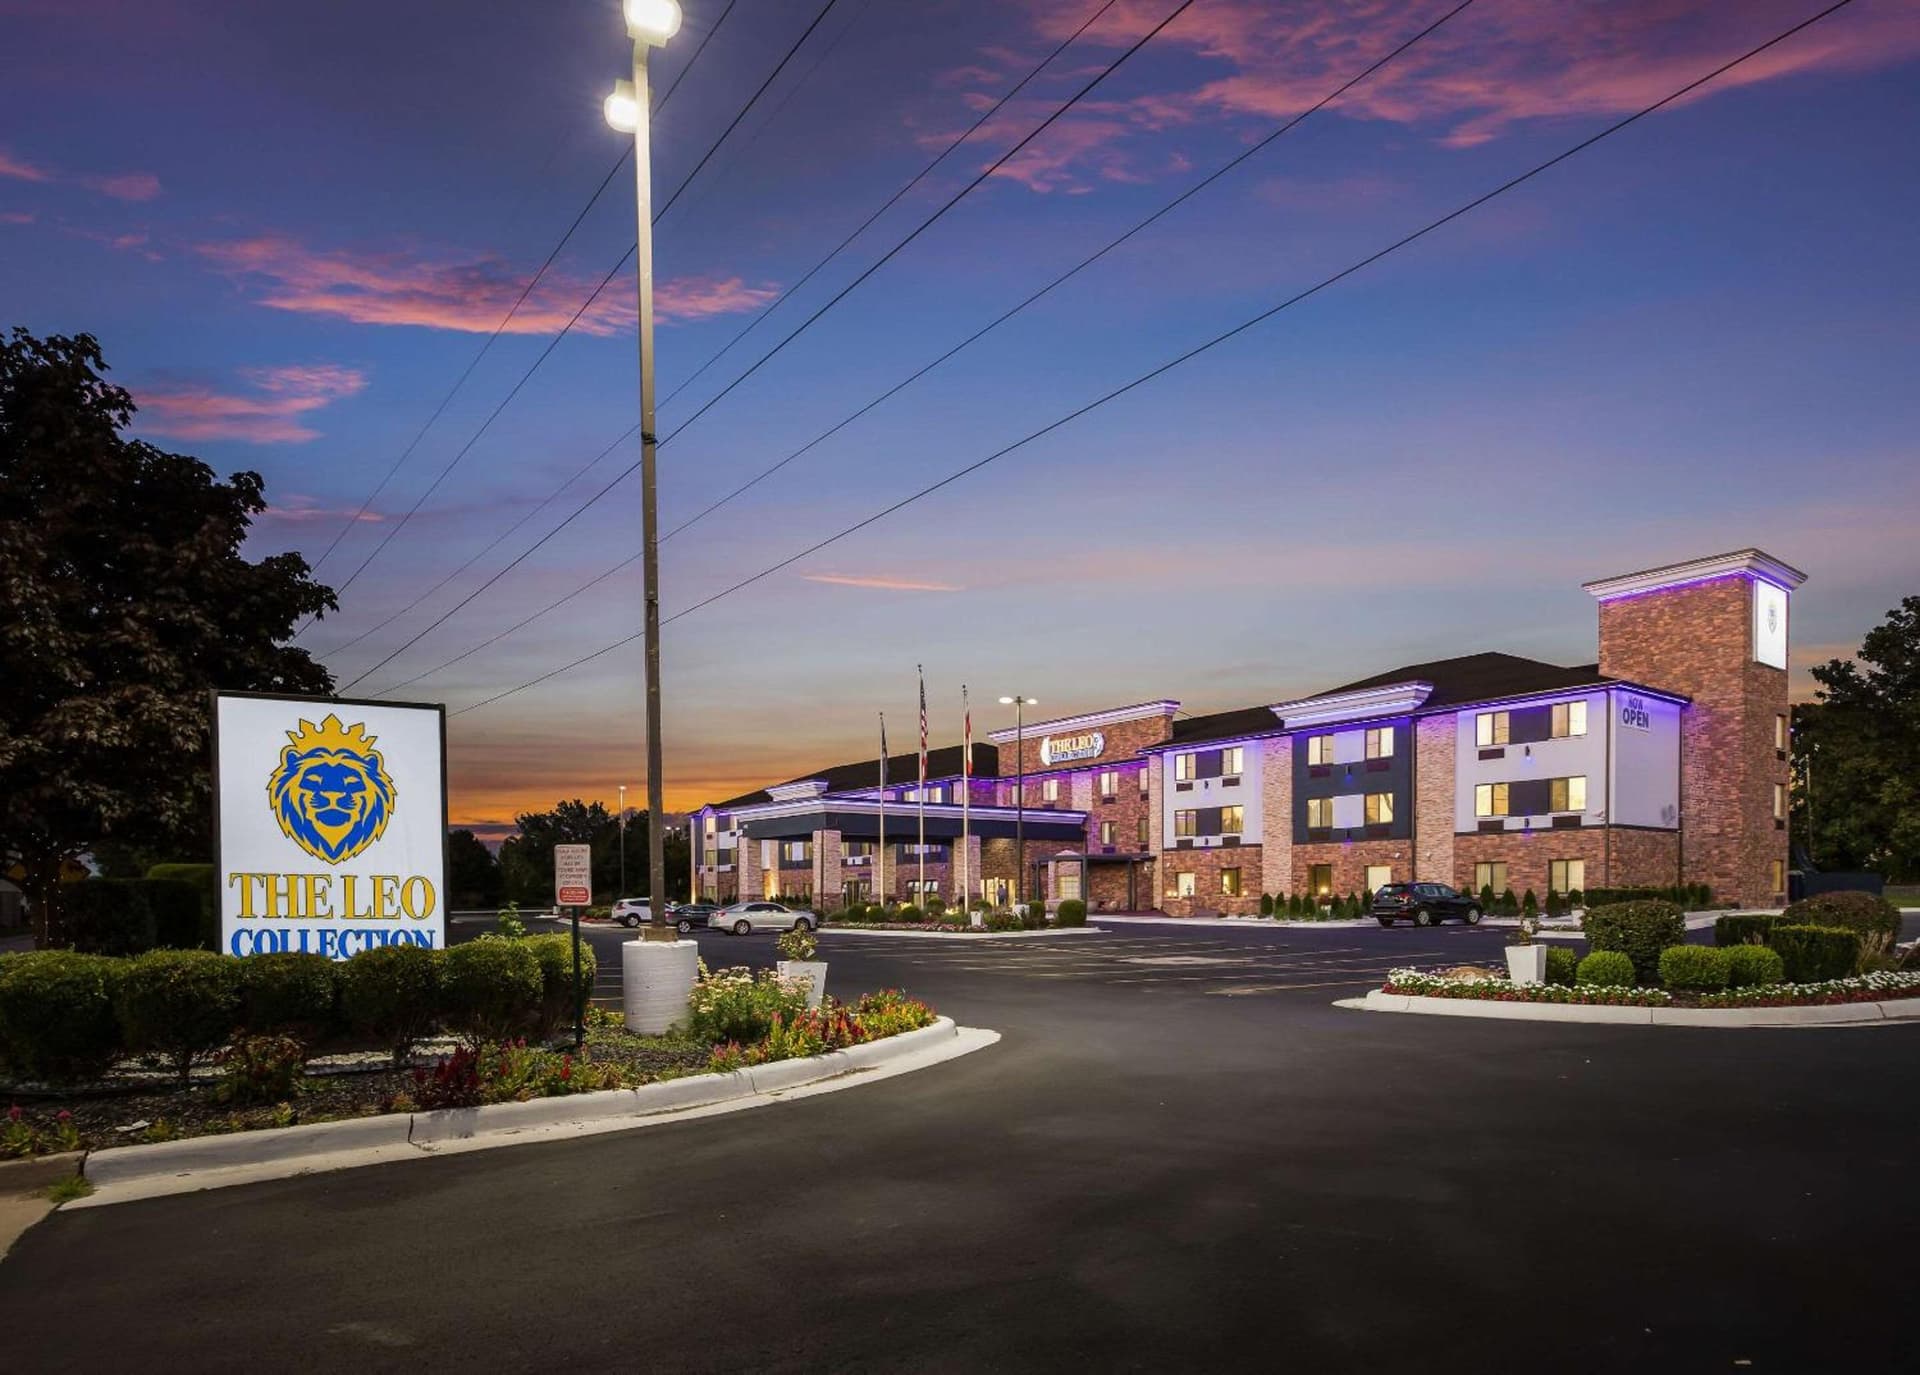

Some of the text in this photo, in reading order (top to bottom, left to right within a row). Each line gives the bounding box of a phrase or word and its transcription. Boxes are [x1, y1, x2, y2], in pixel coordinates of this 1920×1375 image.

[1623, 708, 1649, 728] OPEN
[229, 872, 436, 921] THE LEO
